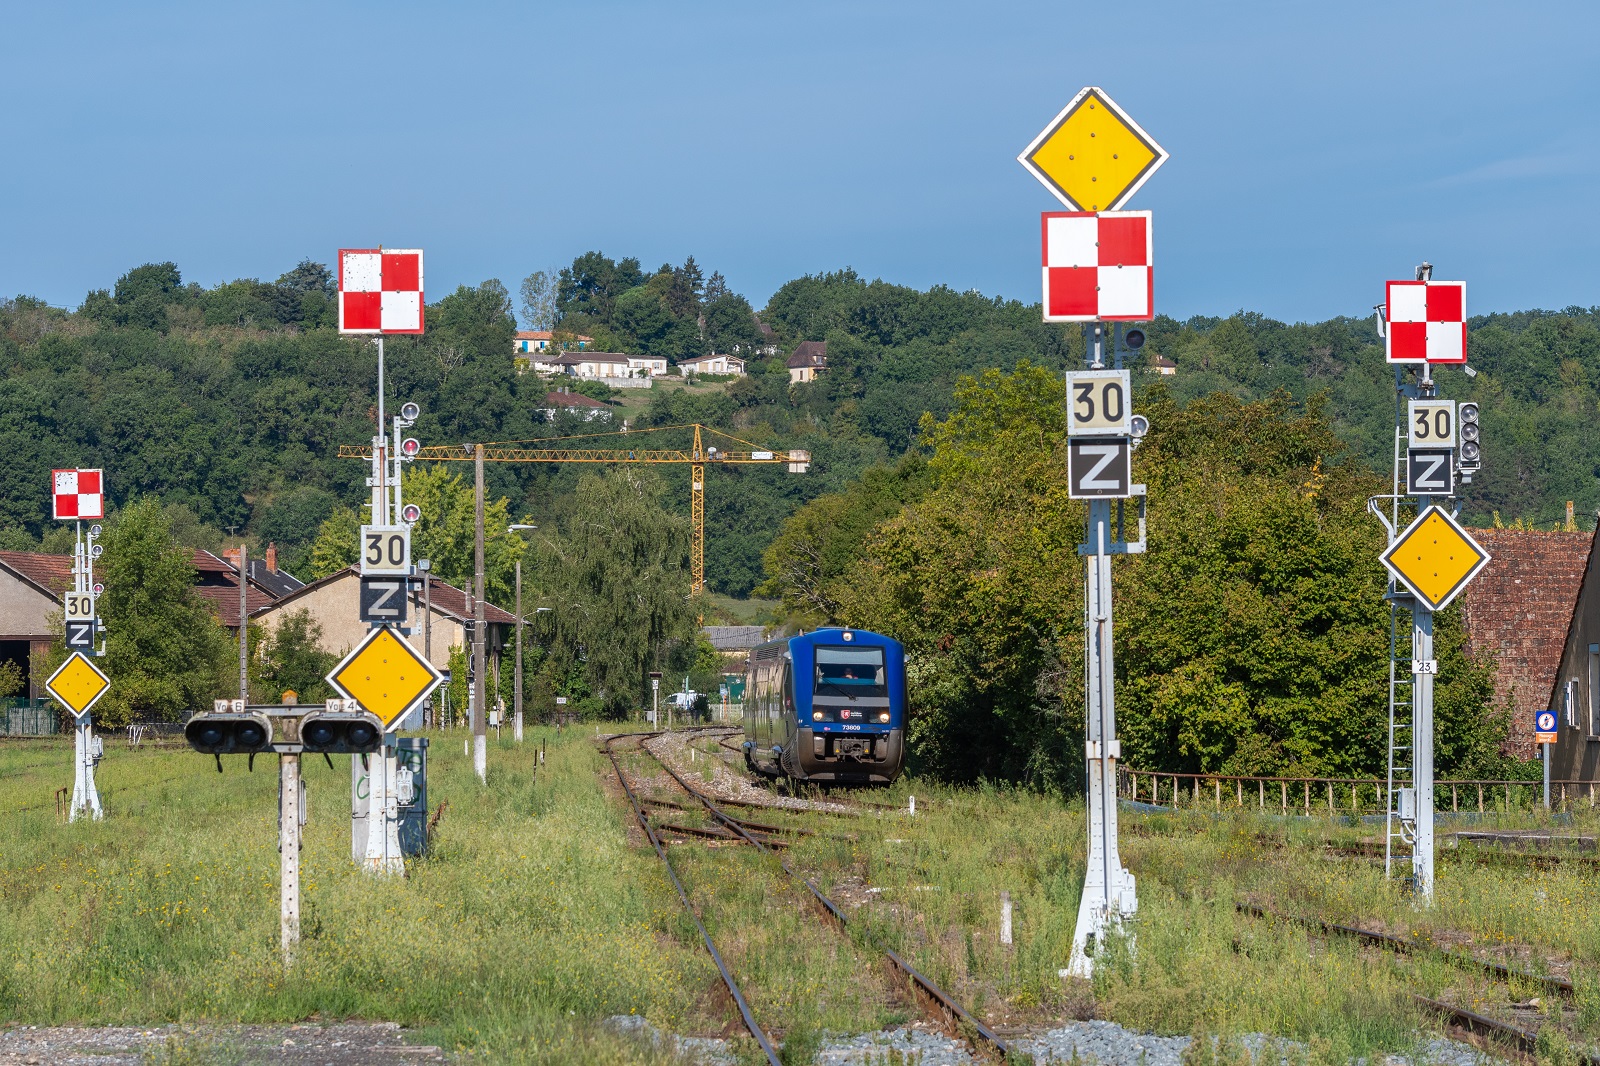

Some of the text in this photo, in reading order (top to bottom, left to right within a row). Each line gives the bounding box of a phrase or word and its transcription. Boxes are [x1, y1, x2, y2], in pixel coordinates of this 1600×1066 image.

[1073, 382, 1124, 423] 30
[1414, 409, 1451, 439] 30
[1079, 445, 1120, 490] Z
[1415, 455, 1445, 488] Z
[366, 534, 405, 565] 30
[68, 597, 91, 616] 30
[368, 582, 400, 616] Z
[70, 625, 90, 645] Z
[1418, 662, 1431, 672] 23
[235, 701, 242, 711] 6
[347, 701, 354, 711] 4
